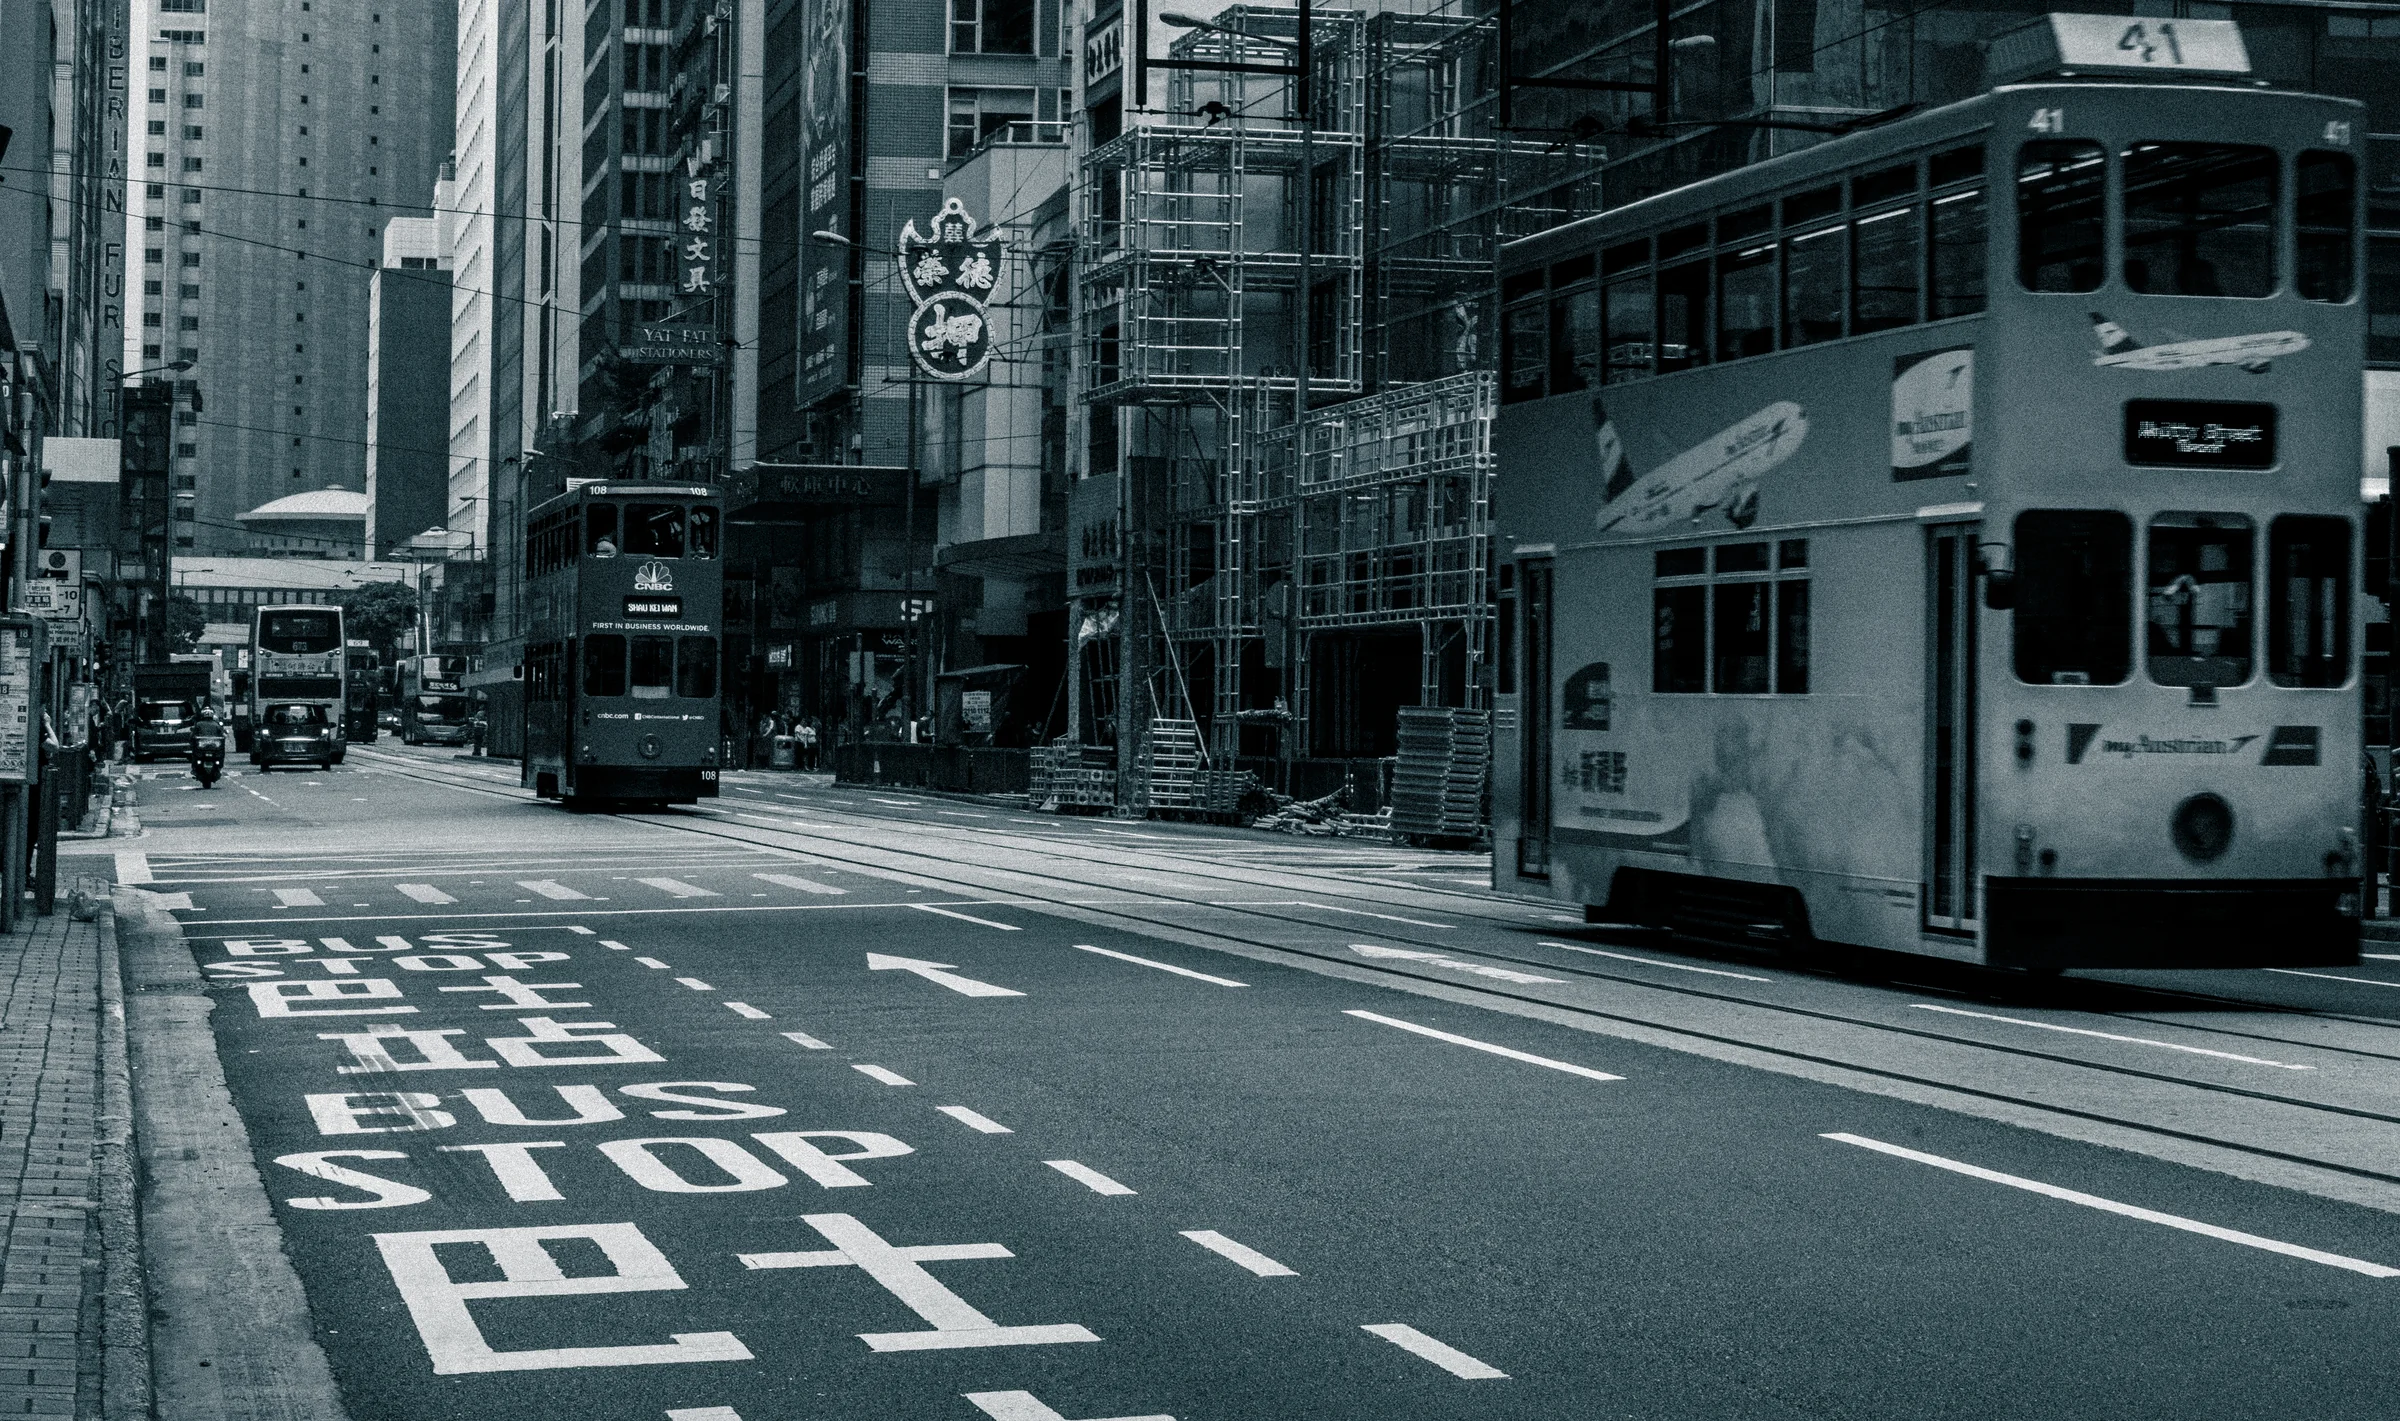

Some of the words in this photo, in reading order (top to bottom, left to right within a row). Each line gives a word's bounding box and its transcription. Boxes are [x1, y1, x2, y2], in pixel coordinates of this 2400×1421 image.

[2118, 22, 2184, 66] 41
[2028, 108, 2064, 133] 41
[2322, 121, 2351, 146] 41
[683, 178, 712, 293] 日發文具
[104, 243, 123, 329] FUR
[643, 328, 671, 343] YAT
[682, 328, 709, 343] FAT
[920, 302, 984, 368] 押
[639, 347, 714, 359] STATIONERS
[589, 486, 608, 495] 108
[690, 487, 708, 497] 108
[634, 583, 673, 591] CNBC
[663, 624, 711, 632] WORLDWIDE.
[292, 641, 308, 652] 673
[701, 770, 717, 781] 108
[222, 932, 513, 957] BUS
[203, 950, 571, 980] STOP
[248, 975, 593, 1019] 巴士
[302, 1081, 789, 1136] BUS
[272, 1130, 917, 1211] STOP
[368, 1212, 1104, 1375] 巴士
